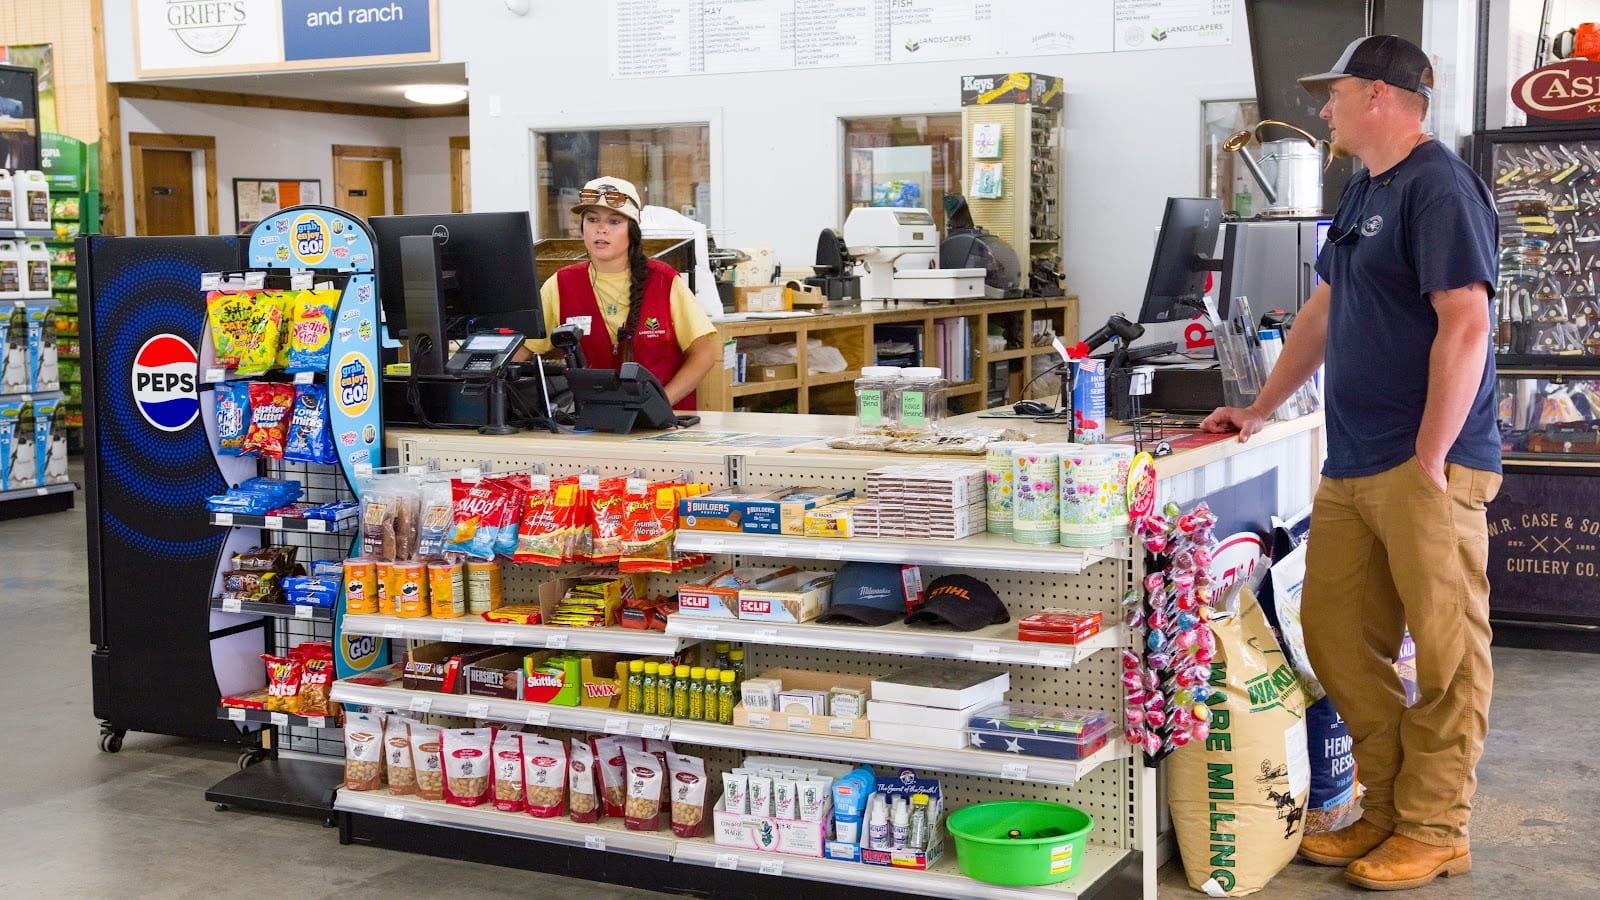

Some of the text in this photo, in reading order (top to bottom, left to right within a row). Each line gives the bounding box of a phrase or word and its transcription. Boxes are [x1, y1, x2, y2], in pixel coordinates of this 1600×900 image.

[167, 2, 247, 26] GRIFF'S
[306, 2, 403, 28] and ranch
[704, 7, 723, 15] HAY
[1167, 23, 1223, 33] LANDSCAPERS
[919, 35, 972, 44] LANDSCAPERS
[963, 77, 994, 95] Keys
[297, 220, 321, 233] grab,
[297, 230, 323, 242] enjoy,
[298, 239, 325, 255] GO!
[341, 363, 365, 377] grab,
[340, 374, 367, 387] enjoy,
[341, 387, 369, 406] GO!
[292, 415, 324, 428] minis
[692, 502, 731, 512] BUILDERS
[750, 506, 775, 514] BUILDERS
[1488, 513, 1600, 538] W.R. CASE & SO
[1507, 558, 1600, 577] CUTLERY CO.
[859, 586, 892, 596] Milwaukee
[929, 585, 971, 601] STIHL
[687, 597, 708, 607] CLIF
[748, 602, 769, 612] CLIF
[348, 637, 376, 660] GO!
[471, 670, 504, 685] HERSHEY'S
[528, 676, 563, 688] Skittles
[269, 684, 298, 696] bits
[584, 682, 616, 698] Twix
[877, 783, 887, 791] The
[1207, 762, 1237, 893] MILLING
